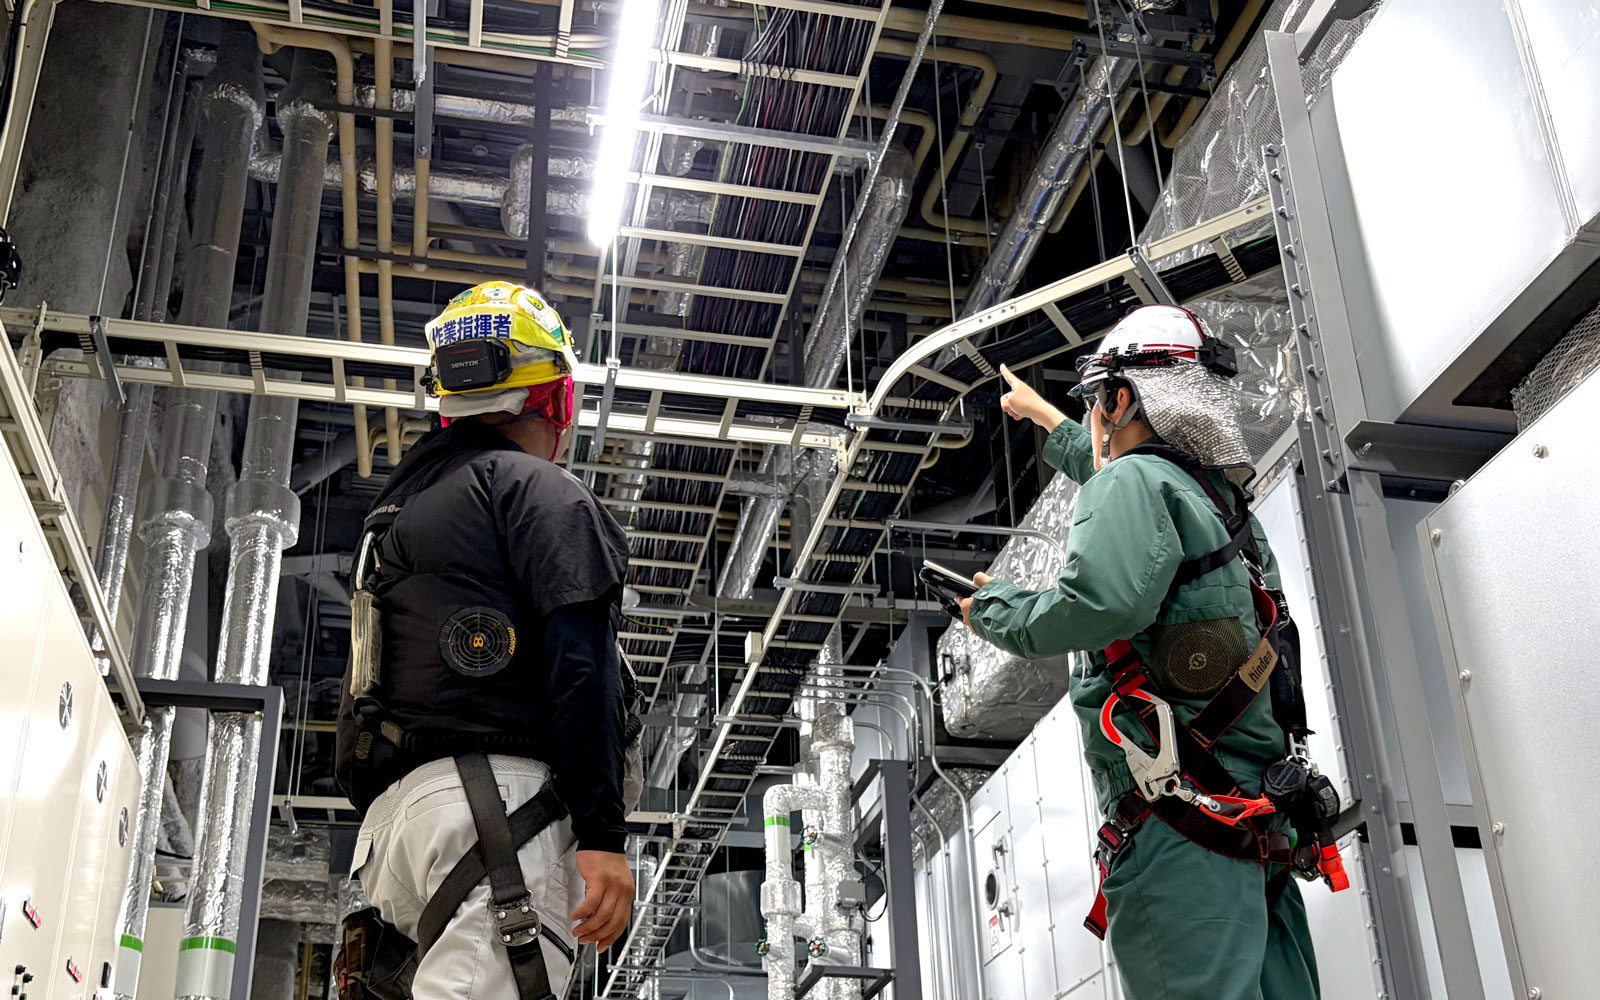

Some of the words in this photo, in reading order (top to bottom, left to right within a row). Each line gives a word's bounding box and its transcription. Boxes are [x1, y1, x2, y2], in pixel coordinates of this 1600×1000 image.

[432, 313, 512, 346] 作業指揮者
[1249, 651, 1273, 683] hinden
